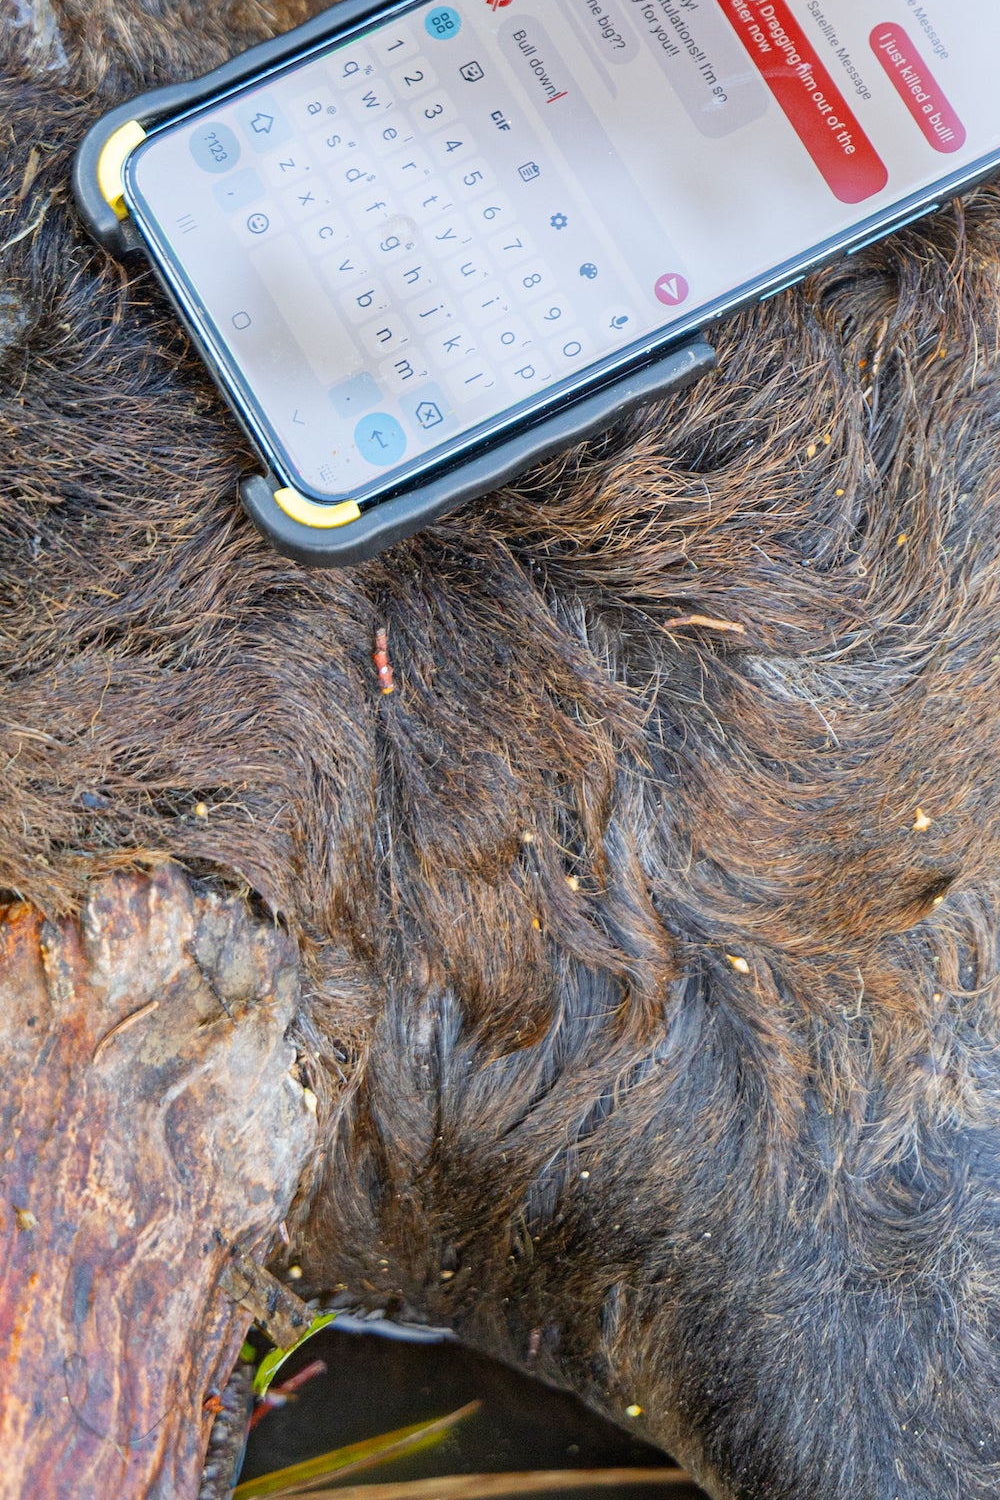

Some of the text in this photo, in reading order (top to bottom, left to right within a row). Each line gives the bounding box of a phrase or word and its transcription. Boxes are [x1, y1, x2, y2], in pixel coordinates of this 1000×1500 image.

[598, 15, 626, 49] big??
[640, 3, 659, 24] for
[649, 24, 680, 58] you!!
[747, 23, 772, 53] now
[911, 6, 949, 60] Message
[512, 29, 563, 99] Bull down!
[759, 4, 802, 66] Dragging
[811, 91, 834, 116] out
[826, 115, 846, 131] of
[836, 130, 856, 155] the
[806, 0, 839, 47] Satellite
[835, 47, 872, 101] Message
[699, 62, 717, 85] I'm
[712, 86, 728, 102] so
[879, 32, 955, 144] I just killed a bull!
[204, 131, 228, 163] ?123
[490, 110, 511, 131] GIF
[307, 101, 323, 116] a
[326, 134, 342, 148] s
[345, 168, 368, 183] d
[365, 202, 387, 212] f
[379, 236, 401, 252] g
[403, 266, 422, 285] h
[418, 304, 444, 318] j
[442, 335, 462, 353] k
[342, 61, 536, 380] q w e r t y u i o p
[387, 39, 582, 358] 1 2 3 4 5 6 7 8 9 0
[279, 157, 414, 381] z x c v b n m
